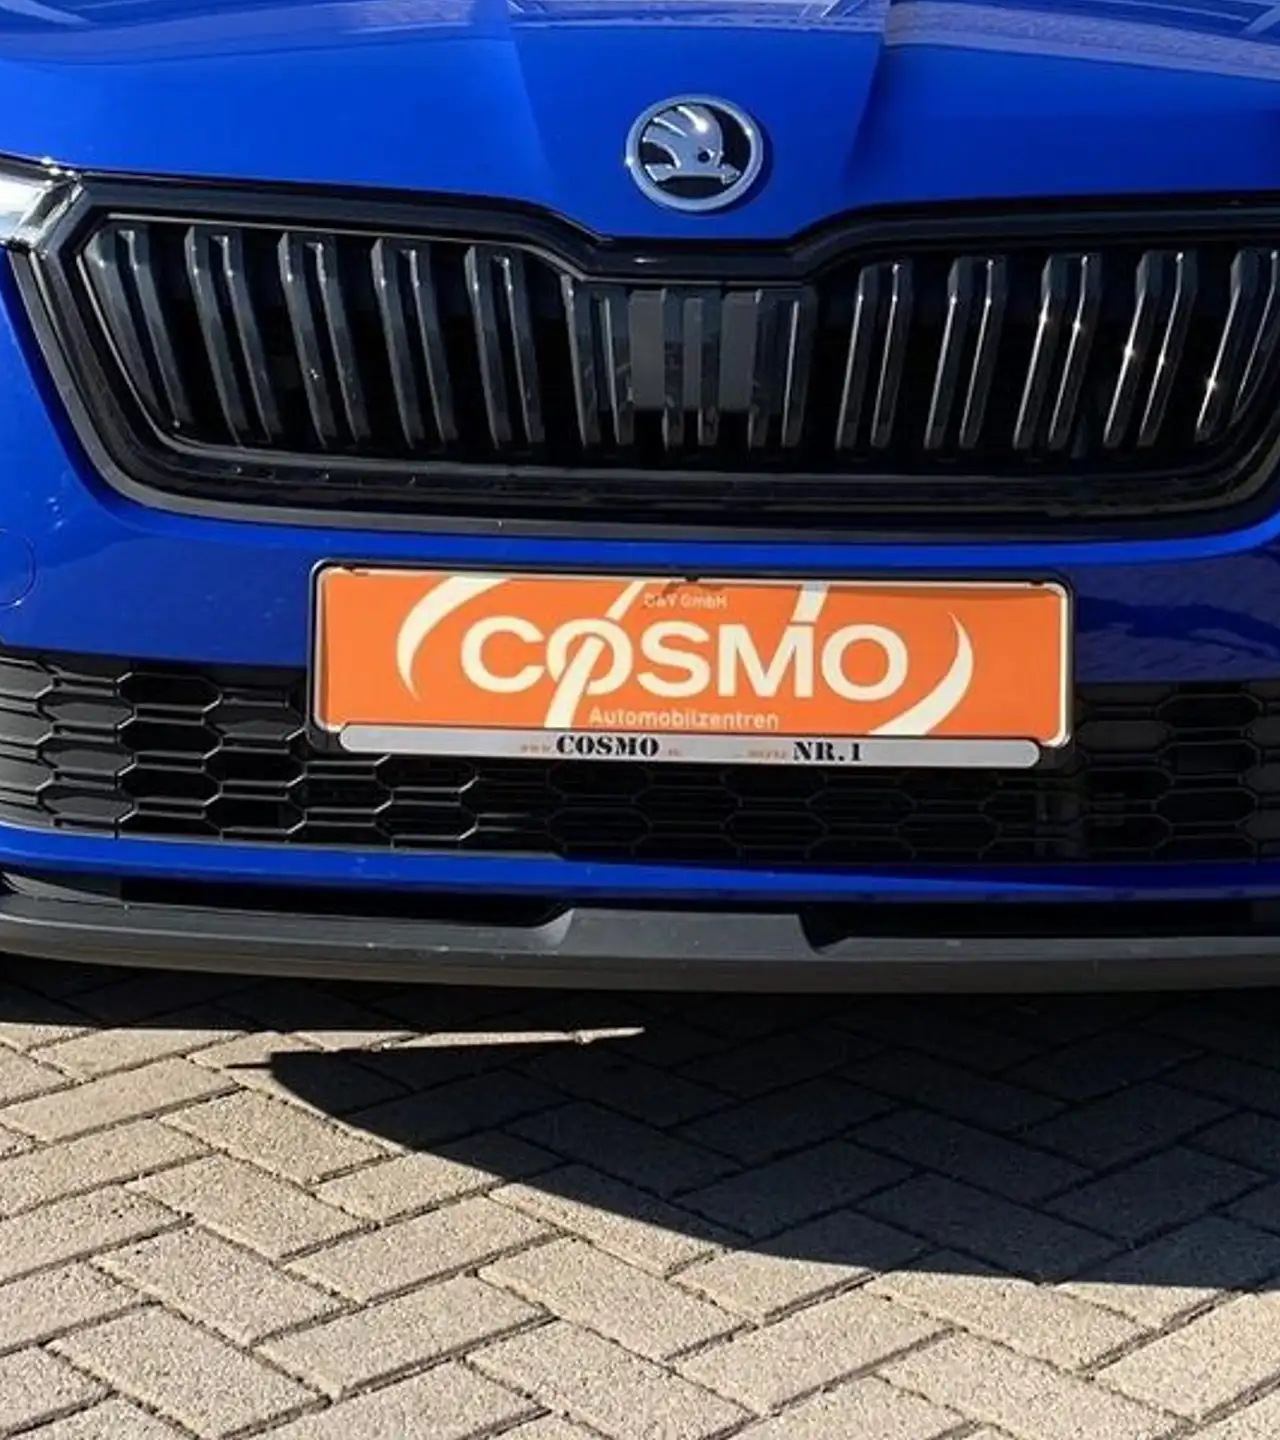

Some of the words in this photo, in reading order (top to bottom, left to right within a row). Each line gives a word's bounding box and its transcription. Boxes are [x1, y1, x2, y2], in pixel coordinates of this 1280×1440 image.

[460, 616, 909, 701] COSMO
[588, 706, 780, 731] Automobilzentren
[556, 734, 660, 758] COSMO
